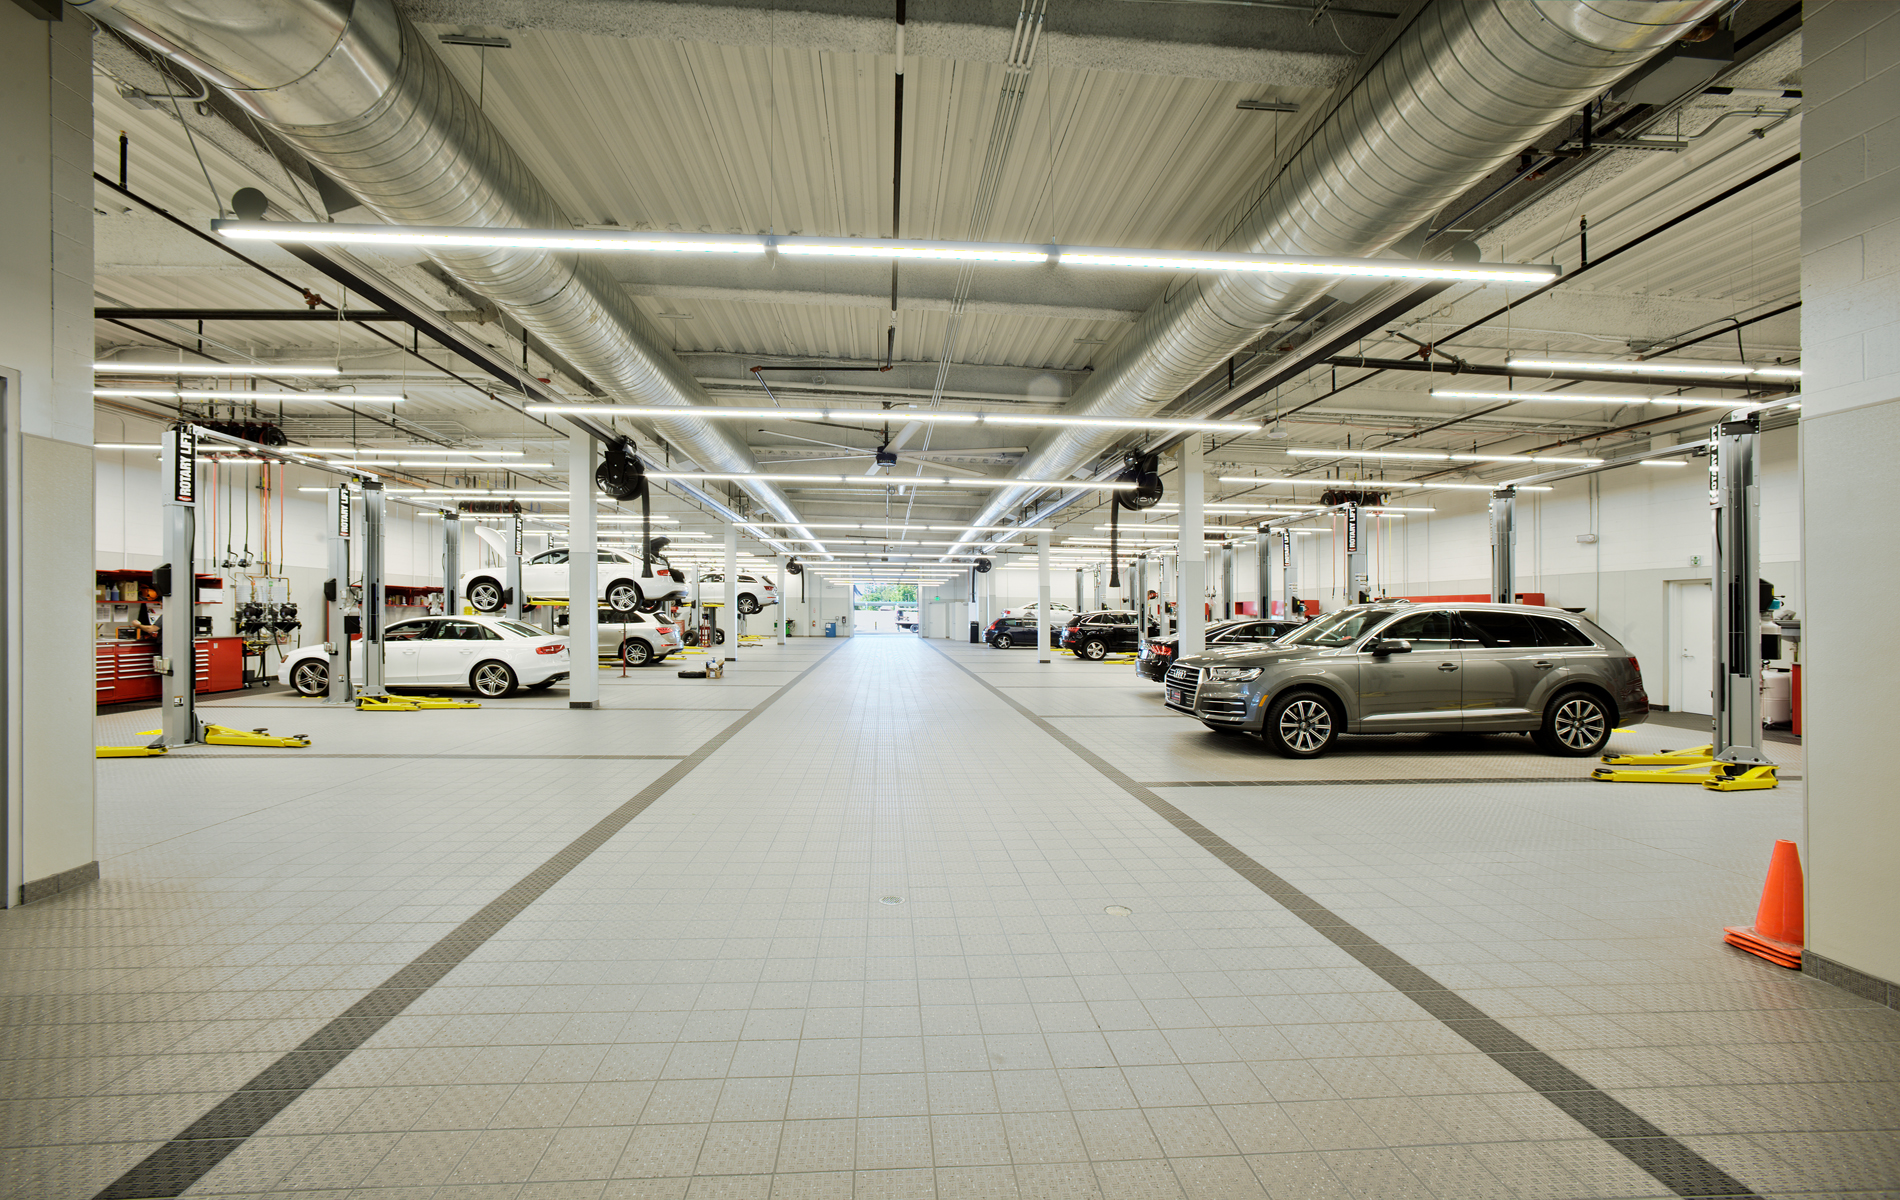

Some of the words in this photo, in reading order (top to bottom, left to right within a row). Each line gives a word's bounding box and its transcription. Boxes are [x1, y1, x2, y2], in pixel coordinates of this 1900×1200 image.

[180, 433, 192, 455] LIFT
[180, 455, 192, 497] ROTARY
[341, 489, 349, 504] LIFT
[341, 505, 349, 533] ROTARY
